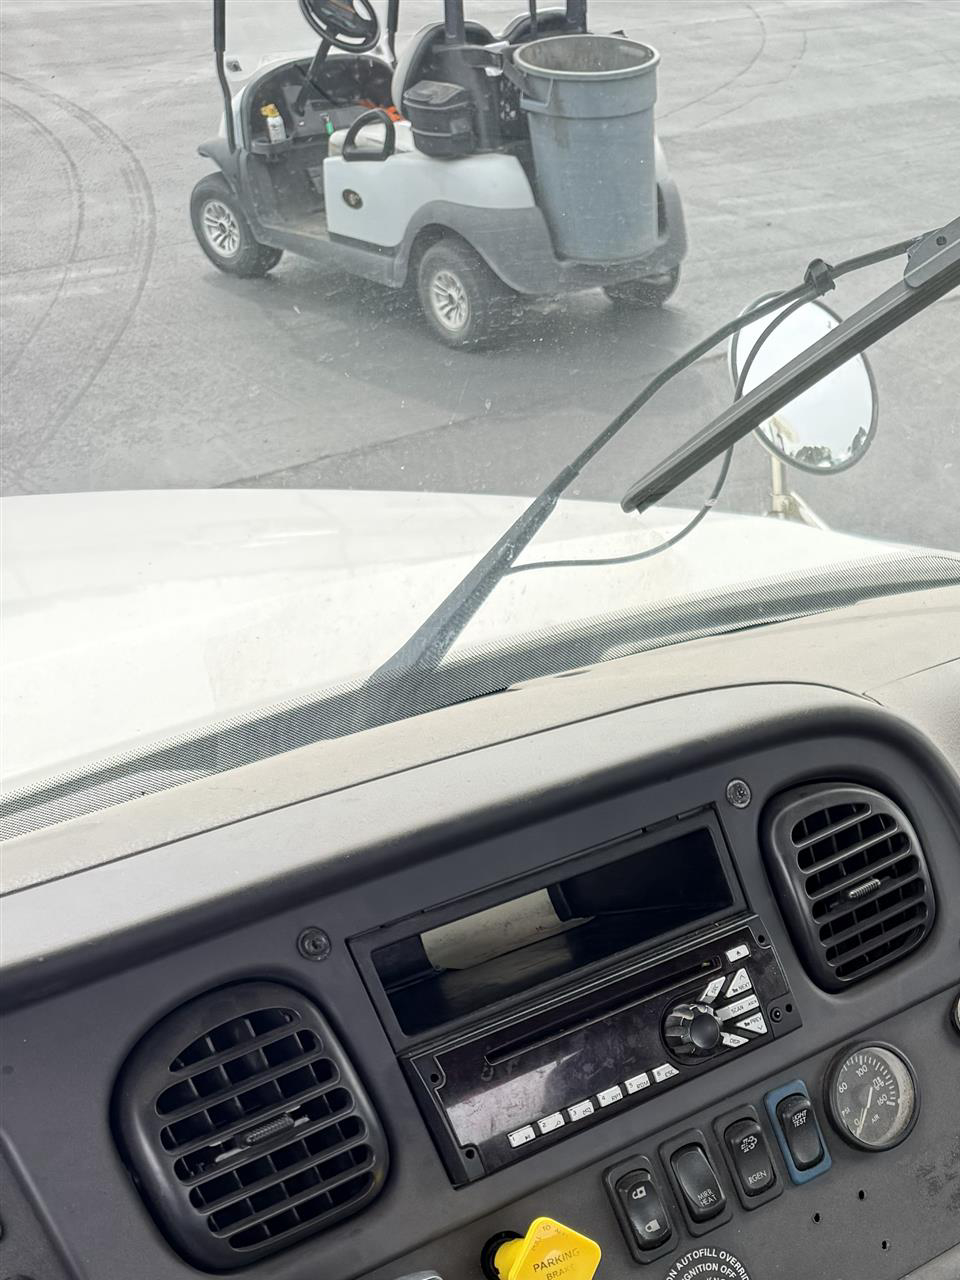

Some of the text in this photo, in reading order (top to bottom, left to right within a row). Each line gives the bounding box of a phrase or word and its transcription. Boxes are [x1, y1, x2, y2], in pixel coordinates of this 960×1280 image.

[856, 1065, 868, 1077] 100
[839, 1082, 848, 1093] 60
[792, 1110, 808, 1122] LIGHT
[794, 1117, 806, 1128] TEST
[748, 1170, 767, 1184] RGEN
[697, 1188, 713, 1200] MIRR
[700, 1194, 717, 1207] HEAT
[533, 1247, 580, 1272] PARKING
[676, 1248, 718, 1272] AUTOFILL
[720, 1265, 737, 1279] OFF
